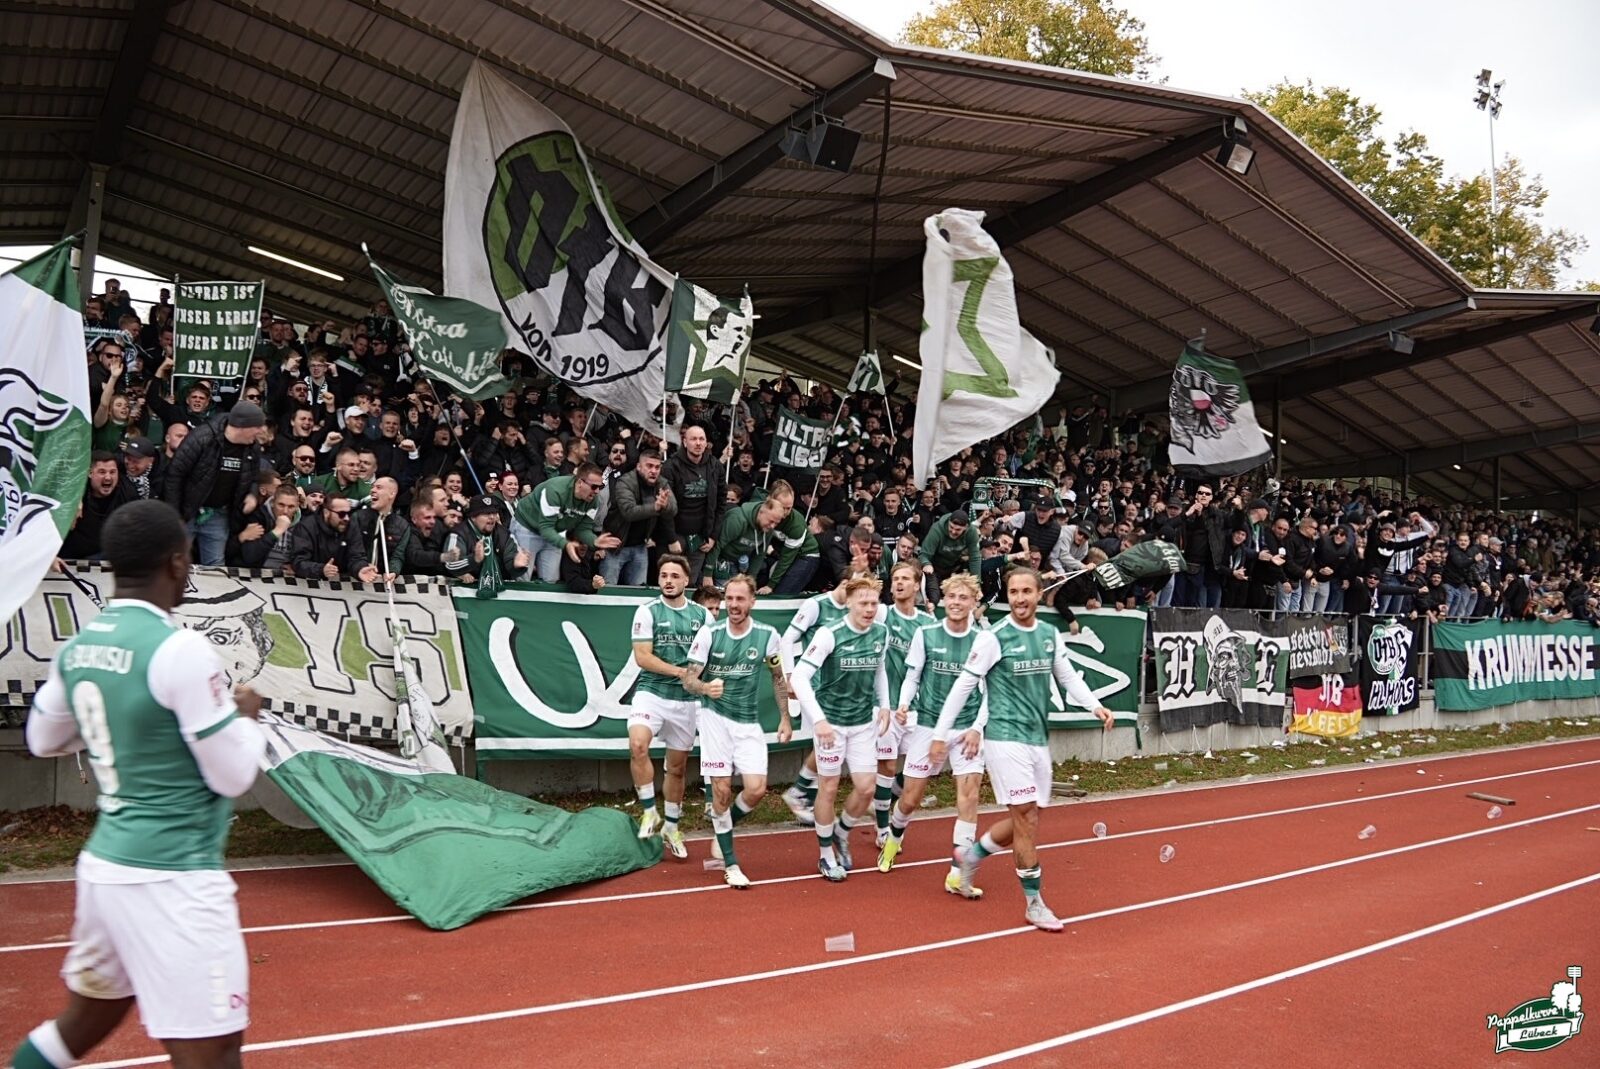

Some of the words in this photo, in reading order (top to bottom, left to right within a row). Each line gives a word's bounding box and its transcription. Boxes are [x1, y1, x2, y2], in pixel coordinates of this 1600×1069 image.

[180, 285, 228, 300] ULTRAS
[233, 285, 256, 299] IST
[188, 360, 212, 374] DER
[560, 353, 609, 381] 1919
[769, 655, 780, 665] C
[840, 658, 857, 666] BTR
[858, 657, 881, 666] SUMU
[1013, 661, 1031, 670] BTR
[1465, 634, 1595, 690] KRUMMESSE
